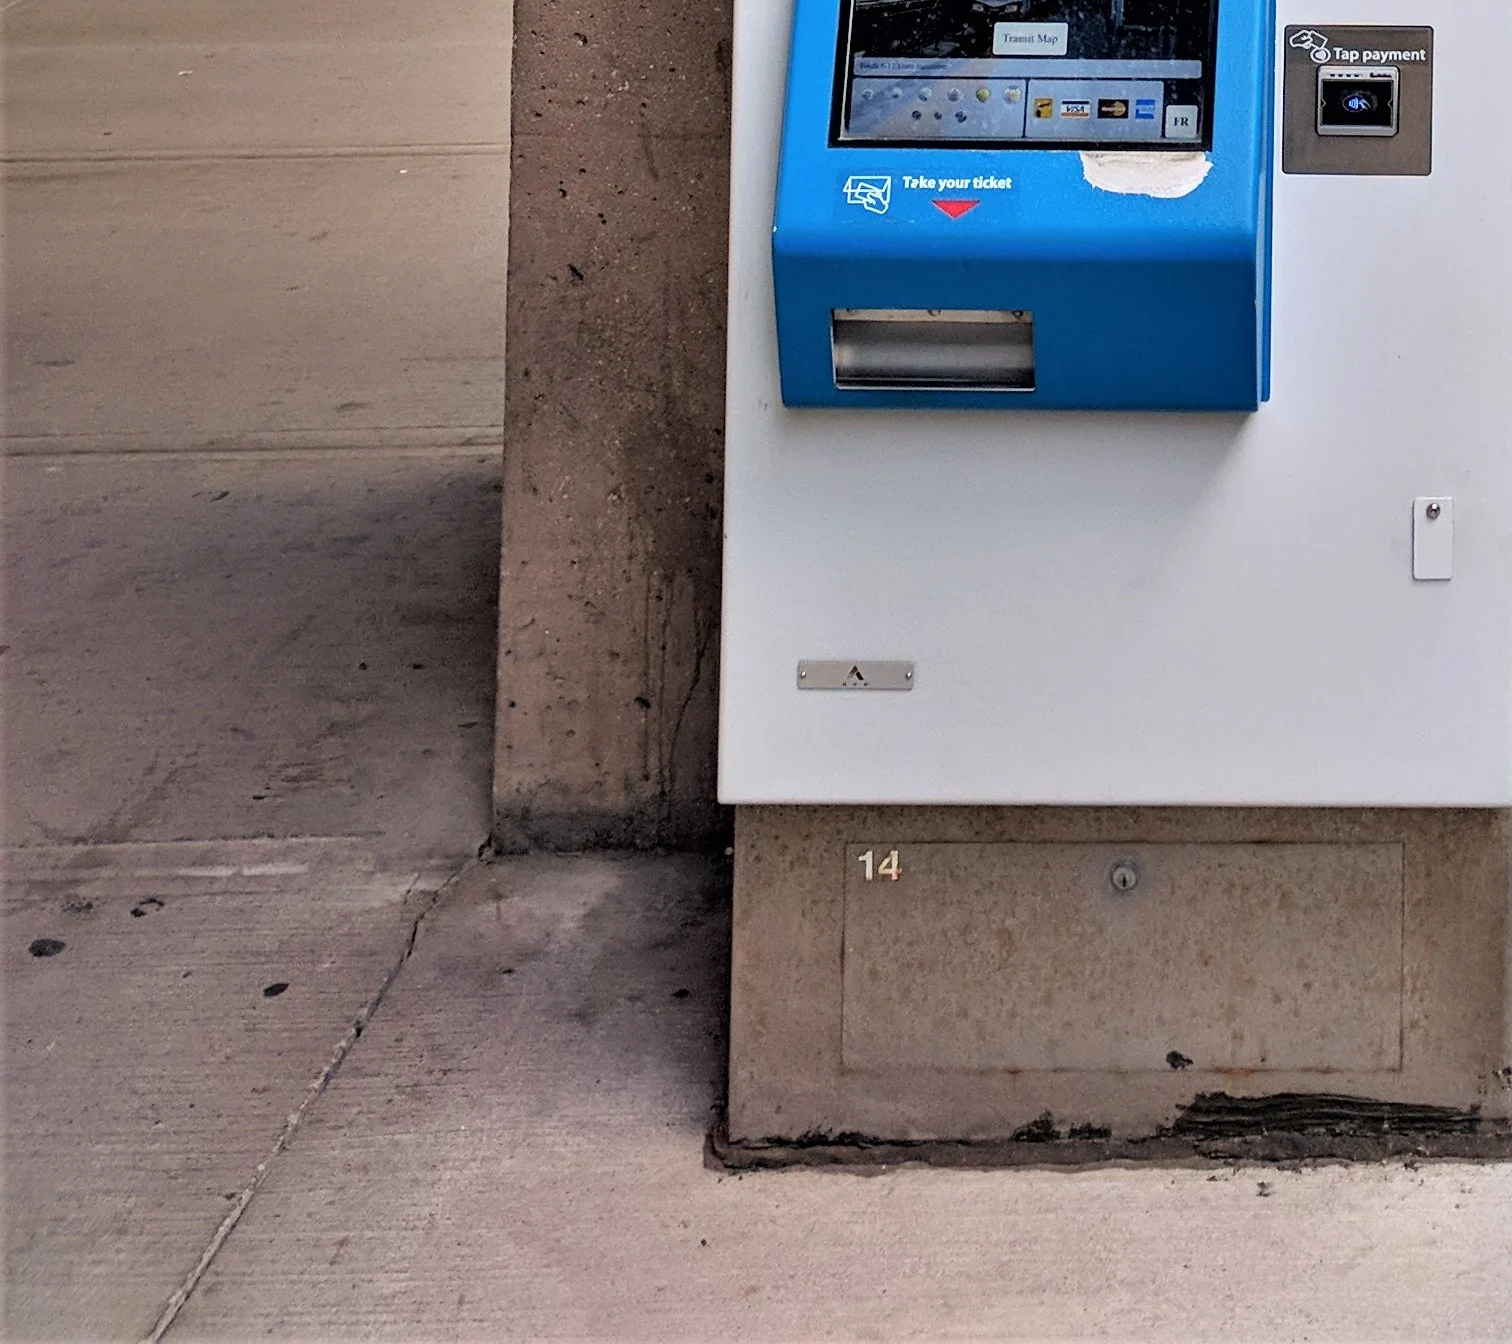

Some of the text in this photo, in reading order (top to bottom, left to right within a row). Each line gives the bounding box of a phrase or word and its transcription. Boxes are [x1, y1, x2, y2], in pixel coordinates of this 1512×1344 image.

[1002, 33, 1059, 46] Transit Map
[1332, 46, 1427, 64] Tap payment
[902, 175, 1013, 192] Take your ticket
[857, 849, 904, 882] 14
